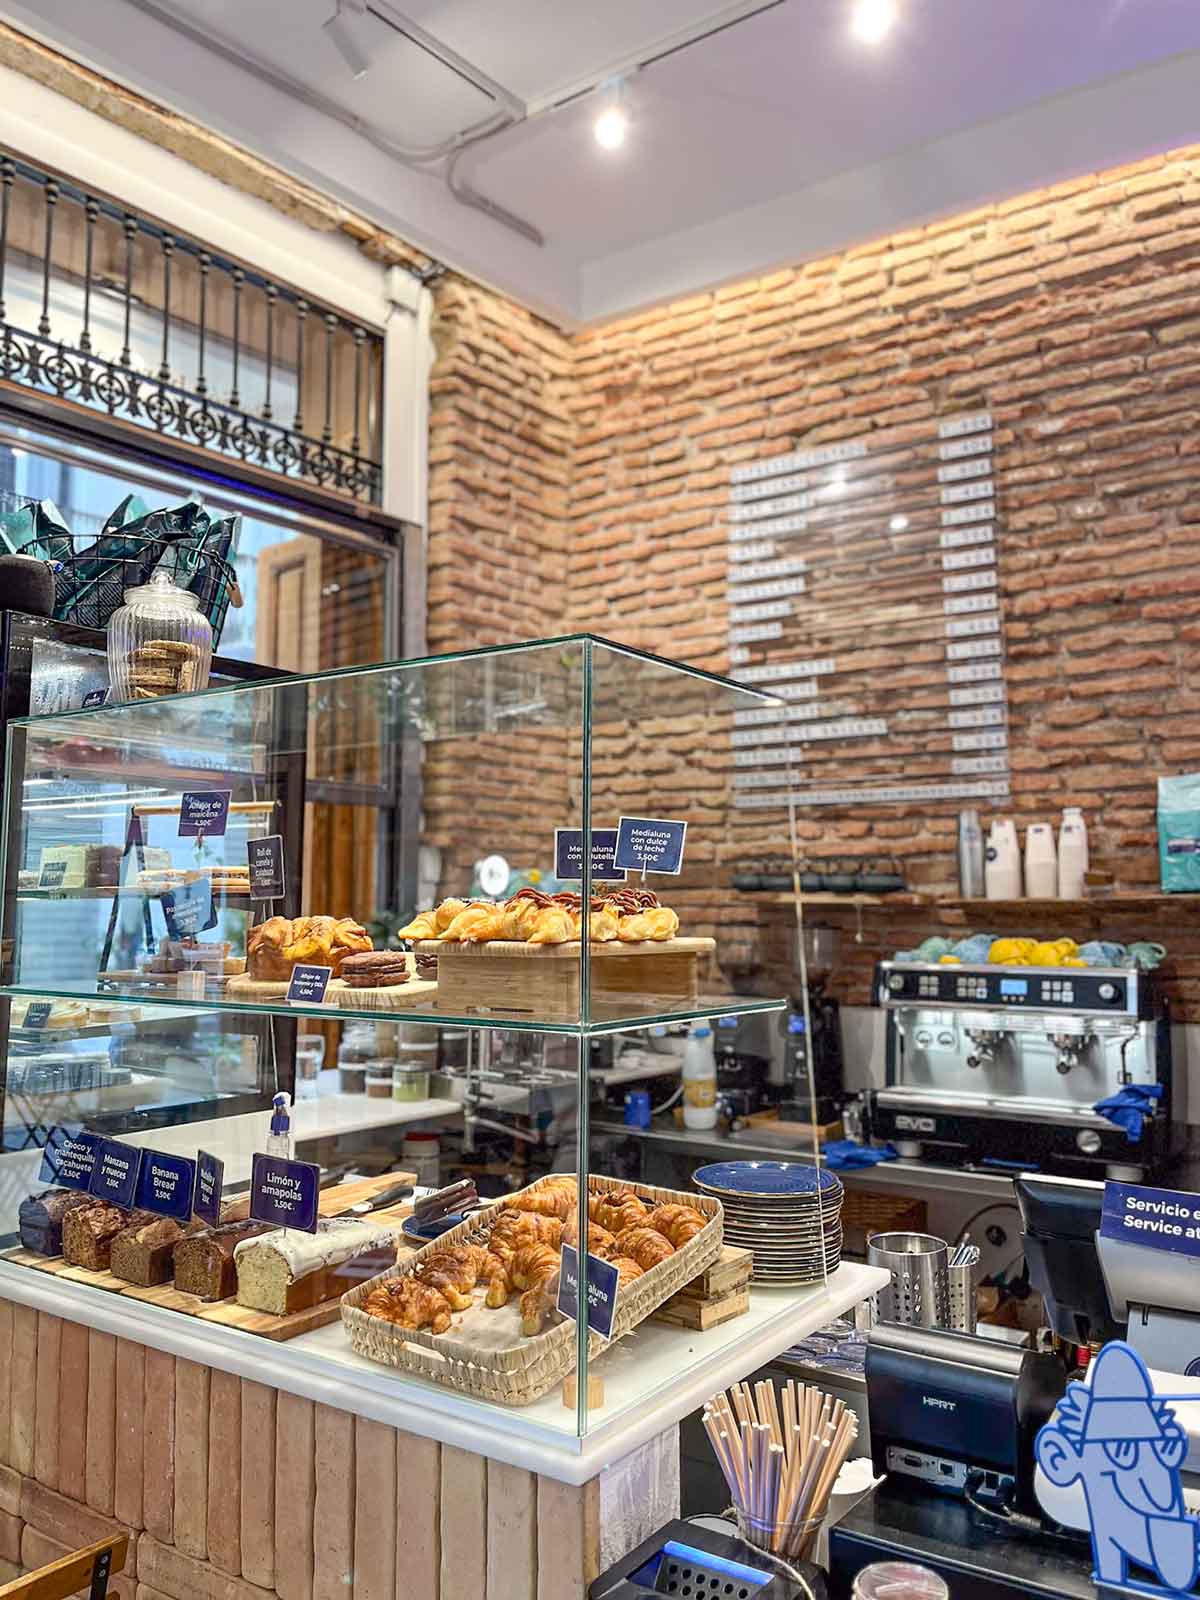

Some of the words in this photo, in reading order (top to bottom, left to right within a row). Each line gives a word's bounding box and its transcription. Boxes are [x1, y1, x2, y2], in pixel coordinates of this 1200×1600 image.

[212, 801, 222, 809] de
[631, 829, 672, 839] Medialuna
[646, 837, 668, 846] dulce
[644, 845, 666, 853] leche
[567, 852, 582, 860] con
[637, 853, 660, 862] 3,50€
[63, 1139, 86, 1152] Choco
[104, 1154, 129, 1170] Manzana
[105, 1167, 127, 1180] nueces
[151, 1166, 180, 1181] Banana
[153, 1177, 176, 1191] Bread
[266, 1172, 294, 1187] Limón
[294, 1180, 301, 1190] y
[154, 1190, 172, 1200] 3,50€
[261, 1185, 302, 1201] amapolas
[1126, 1196, 1190, 1218] Servicio
[1123, 1215, 1183, 1236] Service
